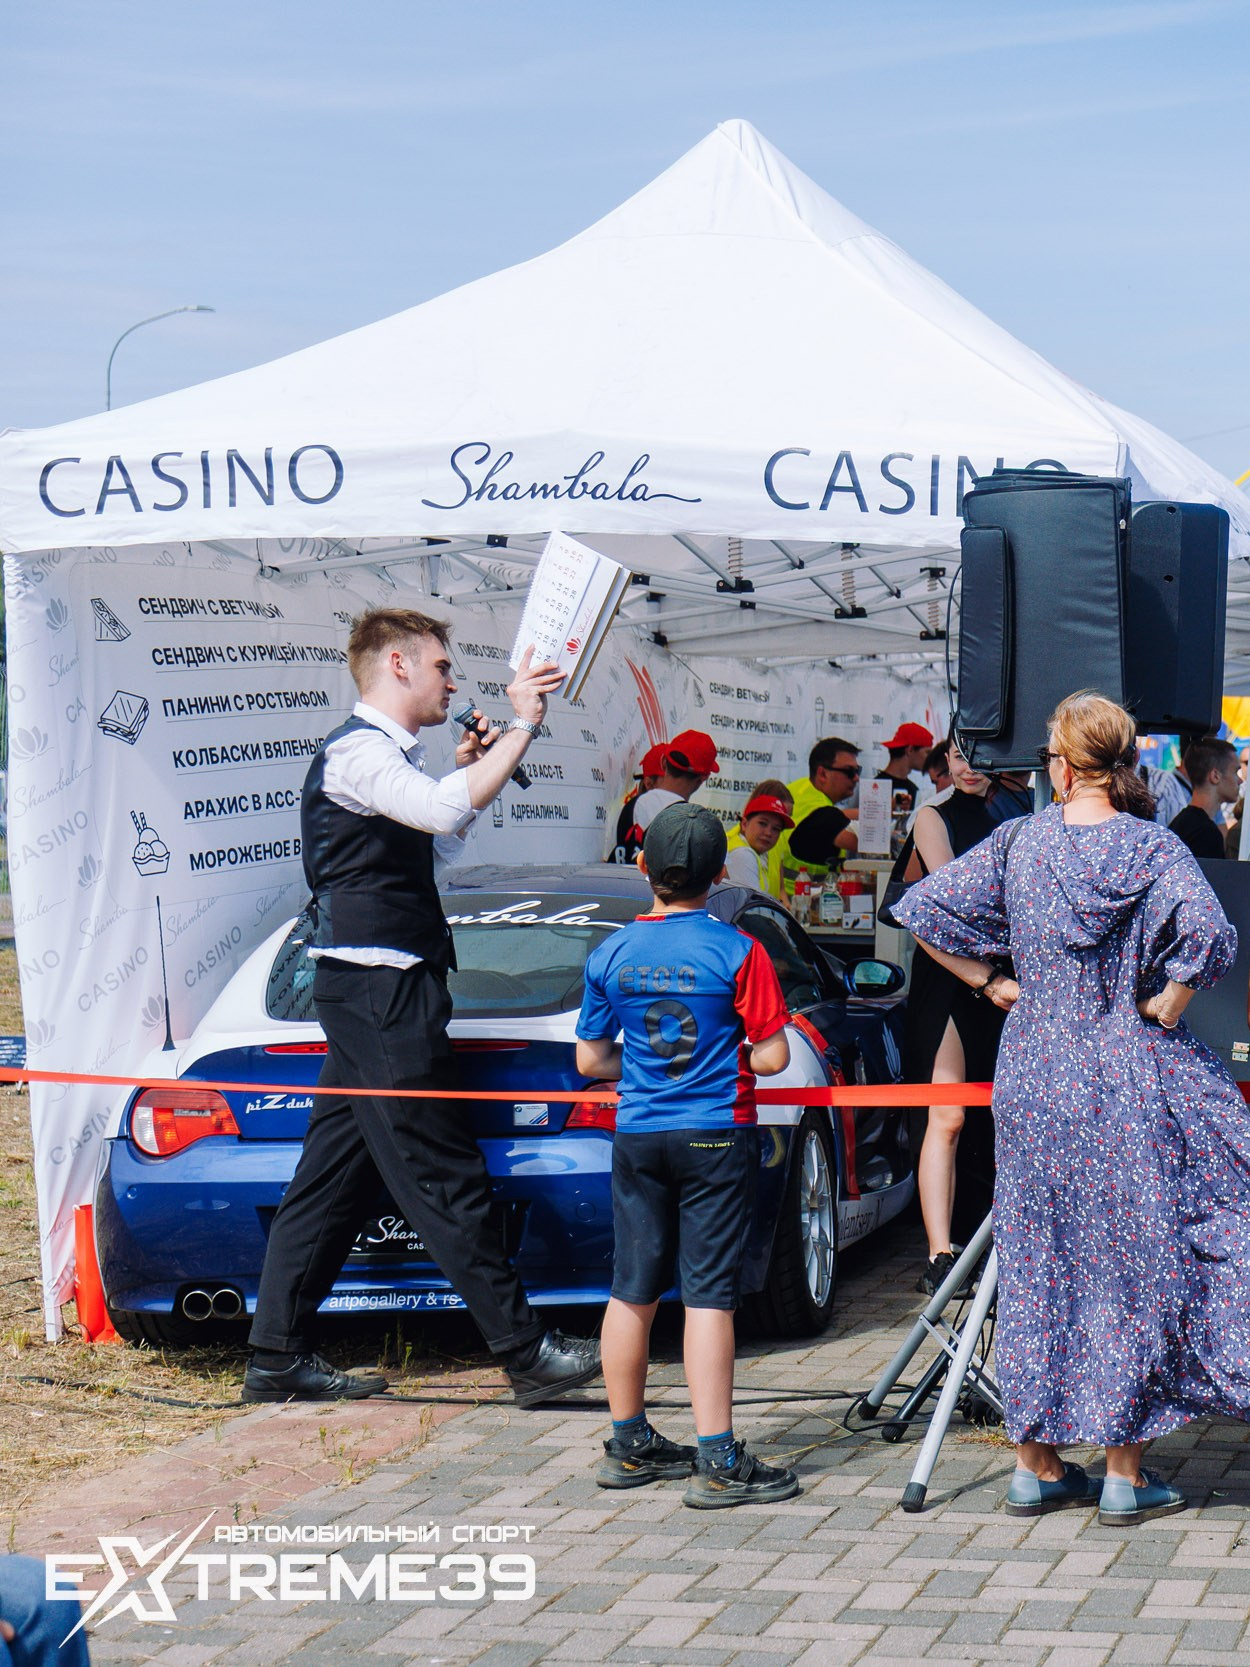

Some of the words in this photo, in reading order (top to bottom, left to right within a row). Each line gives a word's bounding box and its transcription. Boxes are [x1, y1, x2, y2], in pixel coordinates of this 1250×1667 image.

[39, 445, 344, 518] CASINO
[421, 441, 701, 510] Shambala
[763, 447, 1069, 517] CASIN
[138, 597, 206, 618] СЕНДВИЧ
[207, 599, 219, 615] С
[152, 645, 225, 667] СЕНДВИЧ
[227, 646, 238, 662] С
[238, 642, 300, 664] КУРИЦЕЙ
[162, 696, 233, 718] ПАНИНИ
[235, 695, 245, 711] С
[247, 690, 329, 710] РОСТБИФОМ
[173, 743, 262, 769] КОЛБАСКИ
[184, 795, 250, 820] АРАХИС
[252, 793, 262, 811] В
[511, 804, 554, 820] АДРЕНАЛИН
[11, 810, 88, 873] CASINO
[190, 840, 292, 871] МОРОЖЕНОЕ
[293, 837, 302, 857] В
[184, 926, 242, 988] CASINO
[78, 946, 149, 1012] CASINO
[618, 965, 696, 994] ETO'O
[644, 999, 698, 1081] 9
[328, 1292, 421, 1310] artpogallery
[426, 1291, 437, 1306] &
